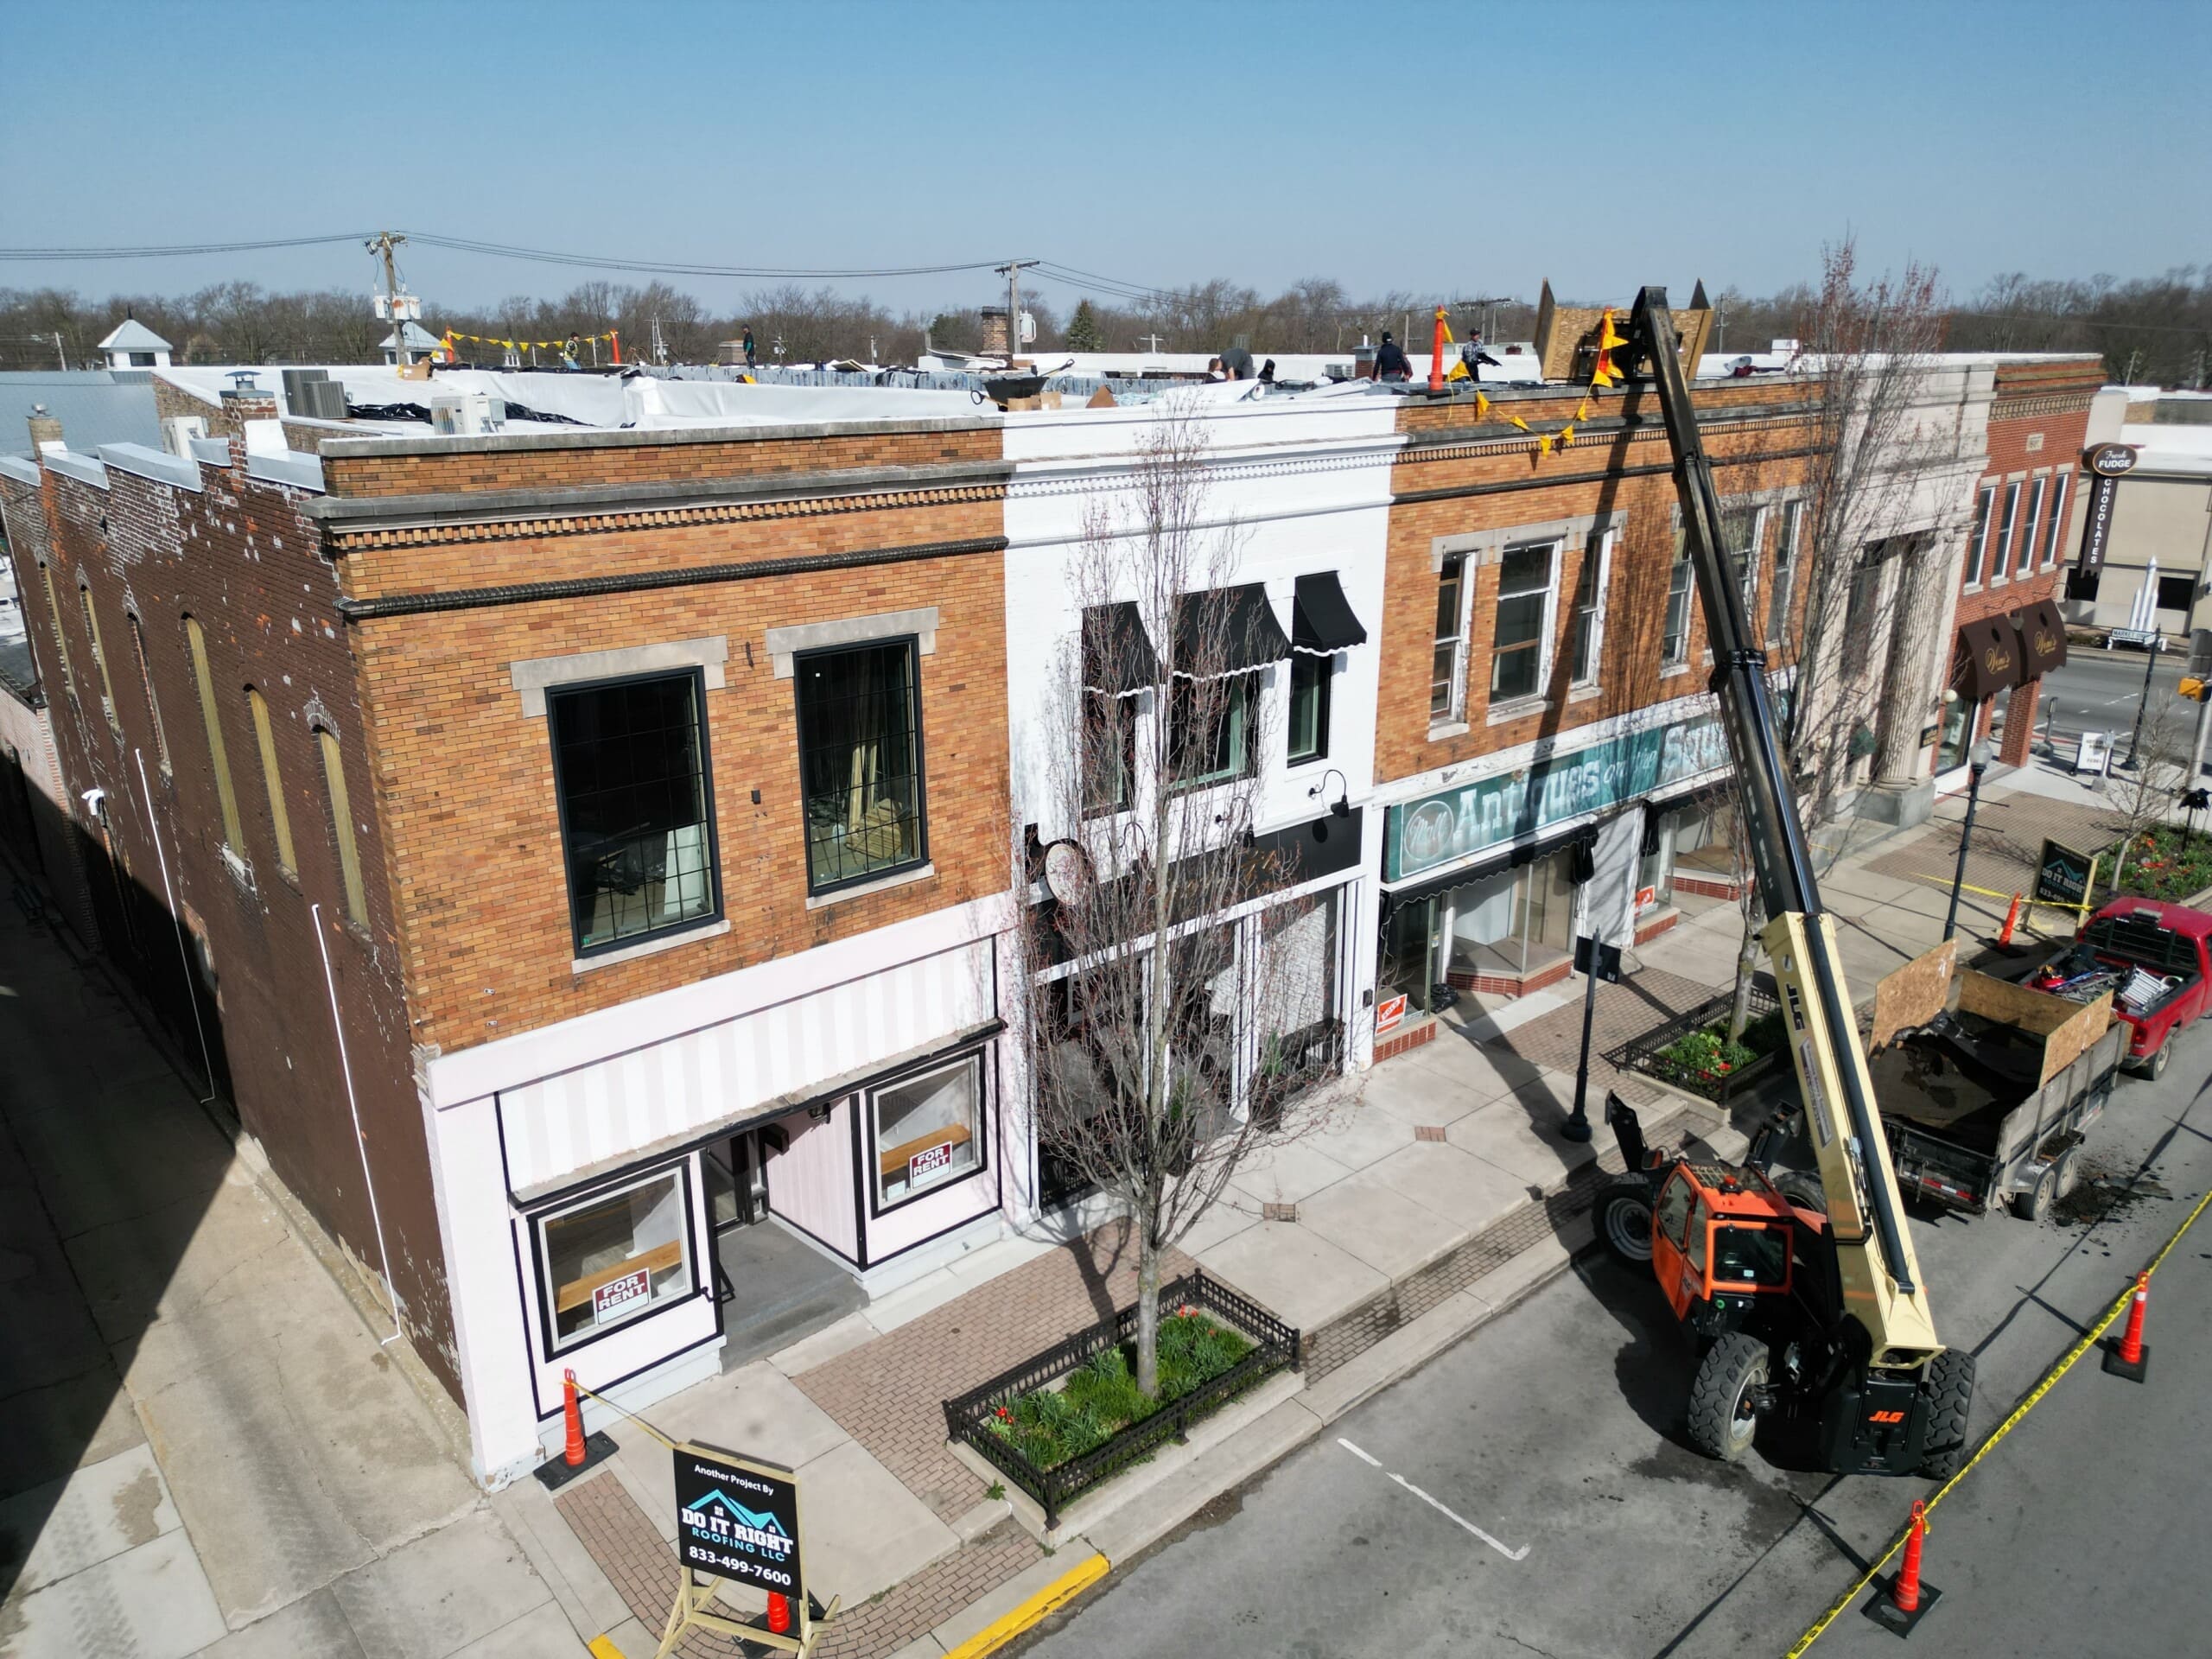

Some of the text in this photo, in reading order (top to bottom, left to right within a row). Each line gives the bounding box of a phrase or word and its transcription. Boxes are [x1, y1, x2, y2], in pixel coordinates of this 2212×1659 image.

[2098, 459, 2132, 469] FUDGE
[2105, 450, 2127, 460] Fresh
[2090, 478, 2113, 564] CHOCOLATES
[1453, 760, 1601, 836] Antiques
[2042, 868, 2085, 894] DO IT RIGHT
[1785, 982, 1806, 1031] JLG
[913, 1154, 949, 1176] RENT
[918, 1147, 944, 1166] FOR
[598, 1283, 645, 1311] RENT
[603, 1275, 639, 1298] FOR
[1868, 1410, 1905, 1423] JLG
[694, 1464, 774, 1497] Another Project By
[681, 1508, 793, 1554] DO IT RIGHT
[692, 1527, 785, 1562] ROOFING LLC
[689, 1546, 791, 1586] 833-499-7600
